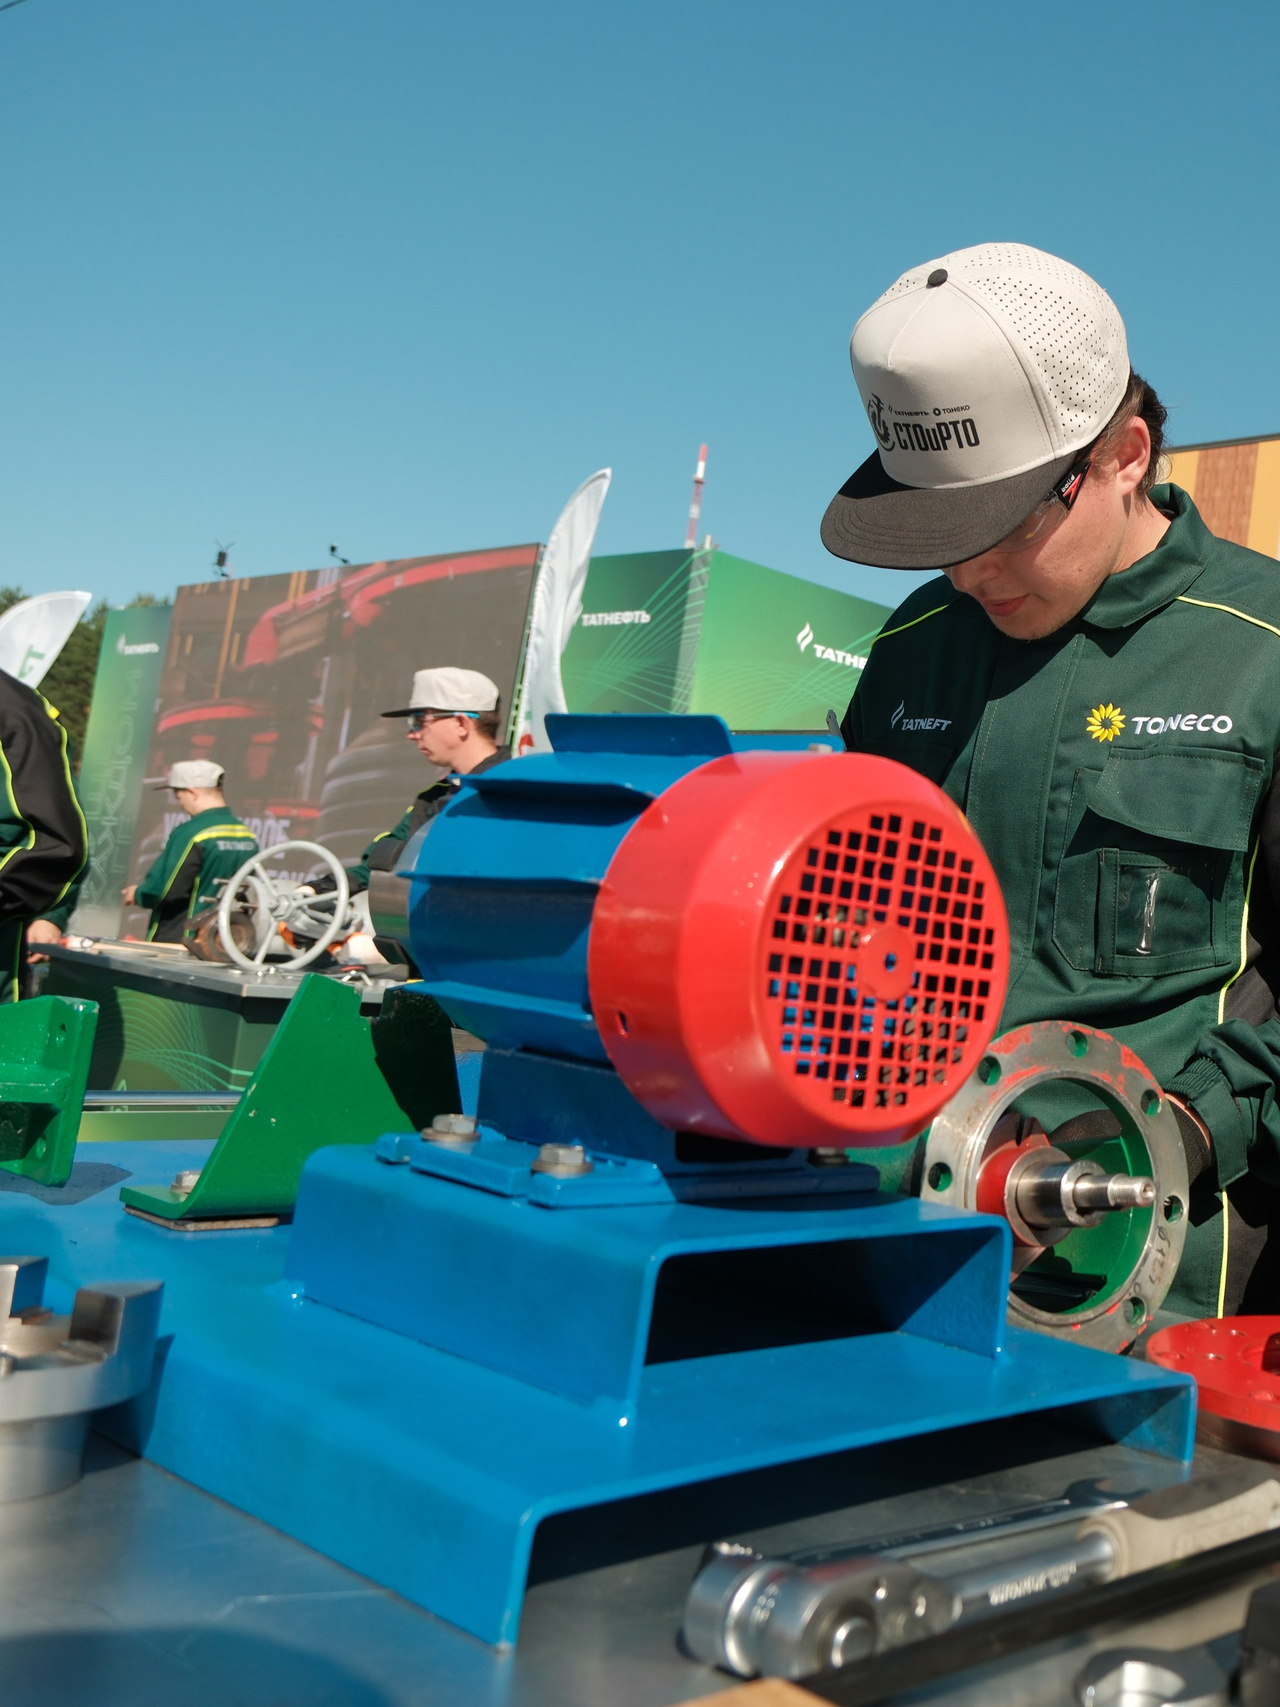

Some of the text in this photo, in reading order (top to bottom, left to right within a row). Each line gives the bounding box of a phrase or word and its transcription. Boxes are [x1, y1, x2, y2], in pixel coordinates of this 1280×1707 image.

[581, 610, 651, 626] ТАТНЕФТЬ
[813, 644, 868, 670] ТАТНЕ
[901, 717, 952, 731] TATNEFT
